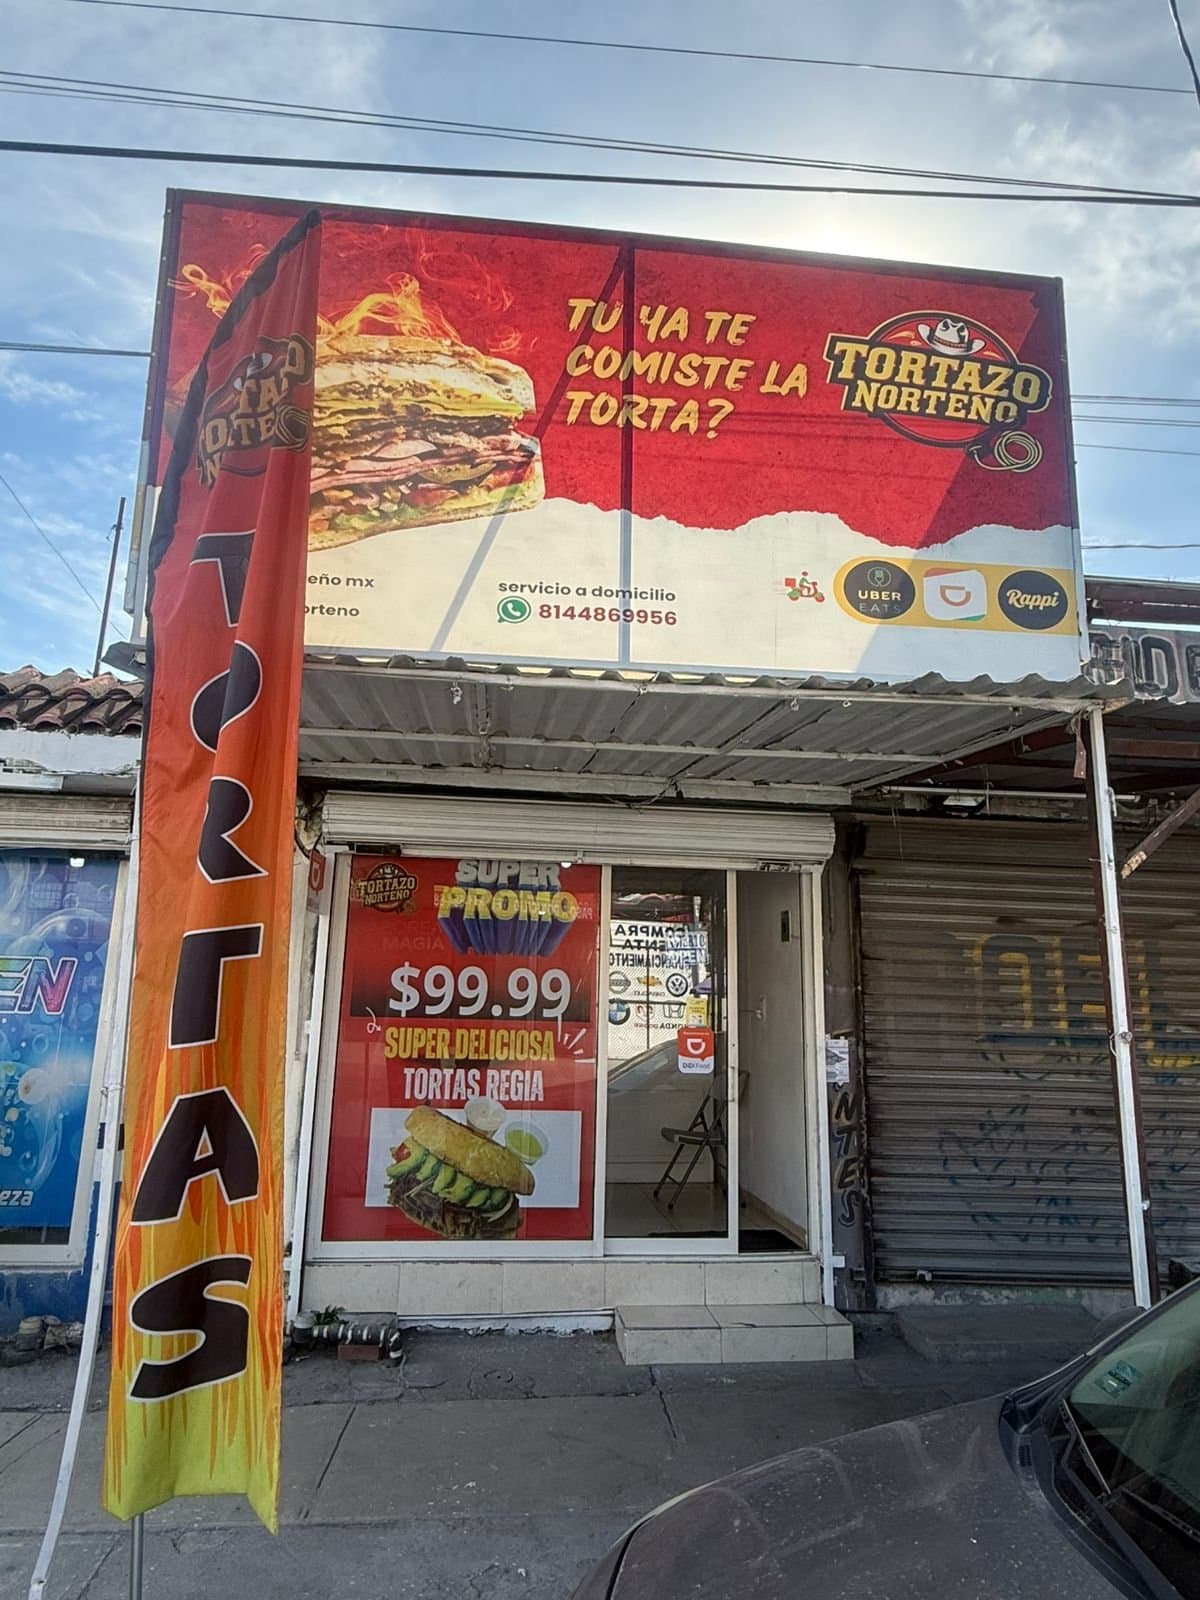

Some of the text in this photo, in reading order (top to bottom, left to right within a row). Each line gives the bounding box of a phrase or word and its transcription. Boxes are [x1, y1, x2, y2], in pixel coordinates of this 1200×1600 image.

[568, 299, 756, 345] TU YA TE
[566, 345, 807, 397] COMISTE LA
[834, 342, 1041, 404] TORTAZO
[565, 391, 735, 439] TORTA?
[346, 577, 375, 588] mx
[498, 580, 676, 602] servicio a domicilio
[857, 590, 901, 602] UBER
[539, 603, 677, 626] 8144869956
[1006, 589, 1060, 611] Rappi
[356, 877, 416, 898] TORTAZO
[455, 859, 561, 888] SUPER
[436, 886, 578, 924] PROMO
[389, 962, 571, 1017] $99.99
[384, 1027, 556, 1061] SUPER DELICIOSA
[404, 1067, 544, 1102] TORTAS REGIA
